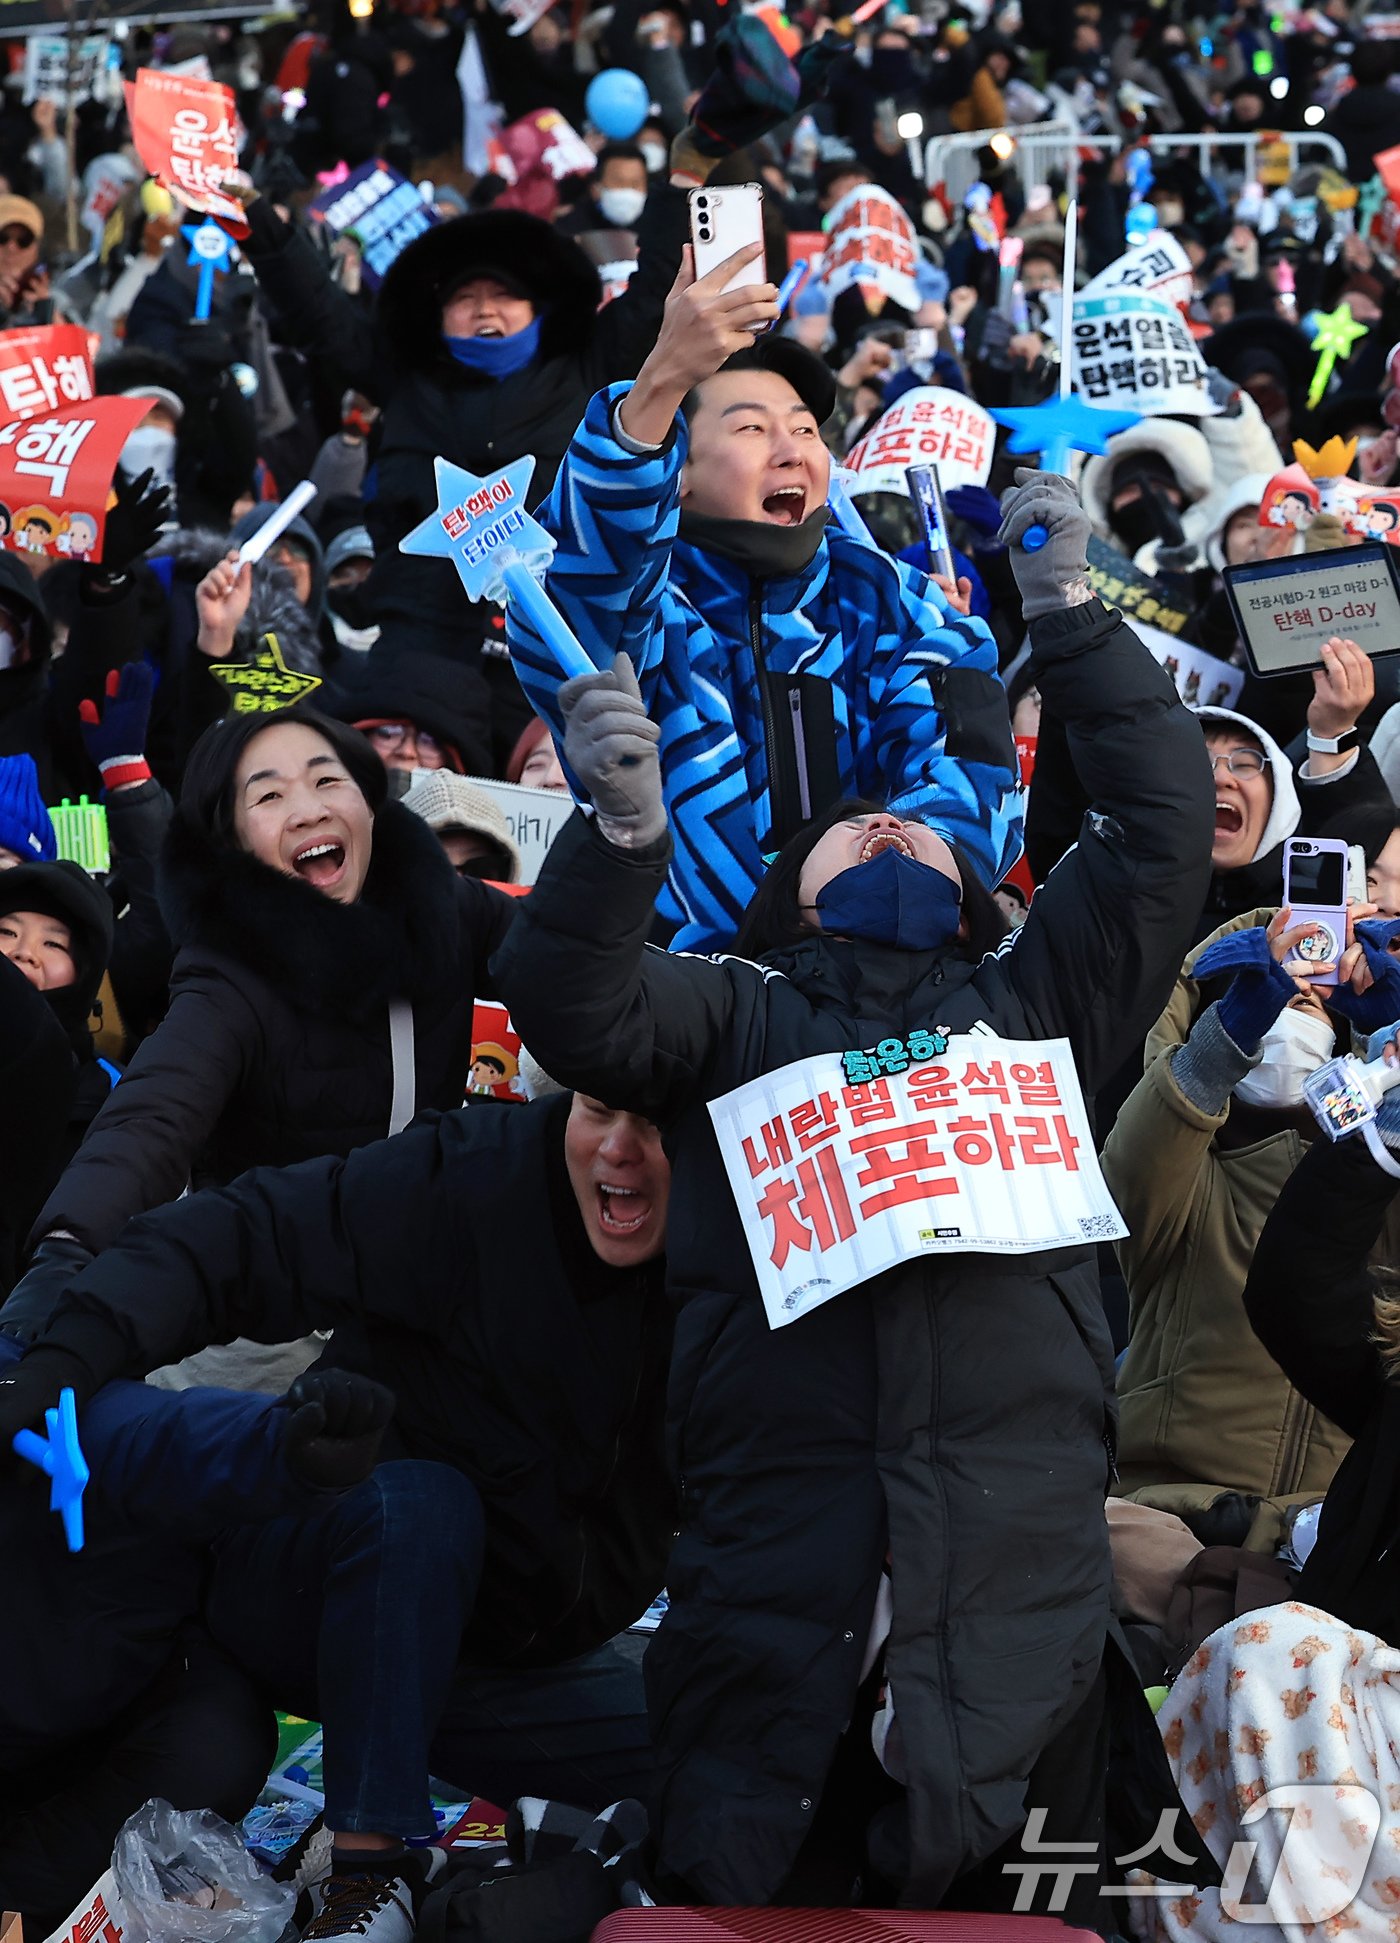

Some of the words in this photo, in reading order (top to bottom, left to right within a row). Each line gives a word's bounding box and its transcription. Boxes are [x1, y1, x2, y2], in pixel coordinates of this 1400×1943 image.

[1080, 357, 1206, 399] 탄핵하라
[912, 401, 987, 441] 윤석열
[441, 477, 515, 540] 탄핵이
[1318, 585, 1342, 599] 원고
[1343, 581, 1368, 594] 마감
[1370, 577, 1389, 589] D-1
[1273, 607, 1315, 632] 탄핵
[1317, 601, 1377, 623] D-day
[741, 1078, 896, 1180] 내란범
[906, 1060, 1063, 1112] 윤석열
[756, 1112, 1081, 1271] 체포하라
